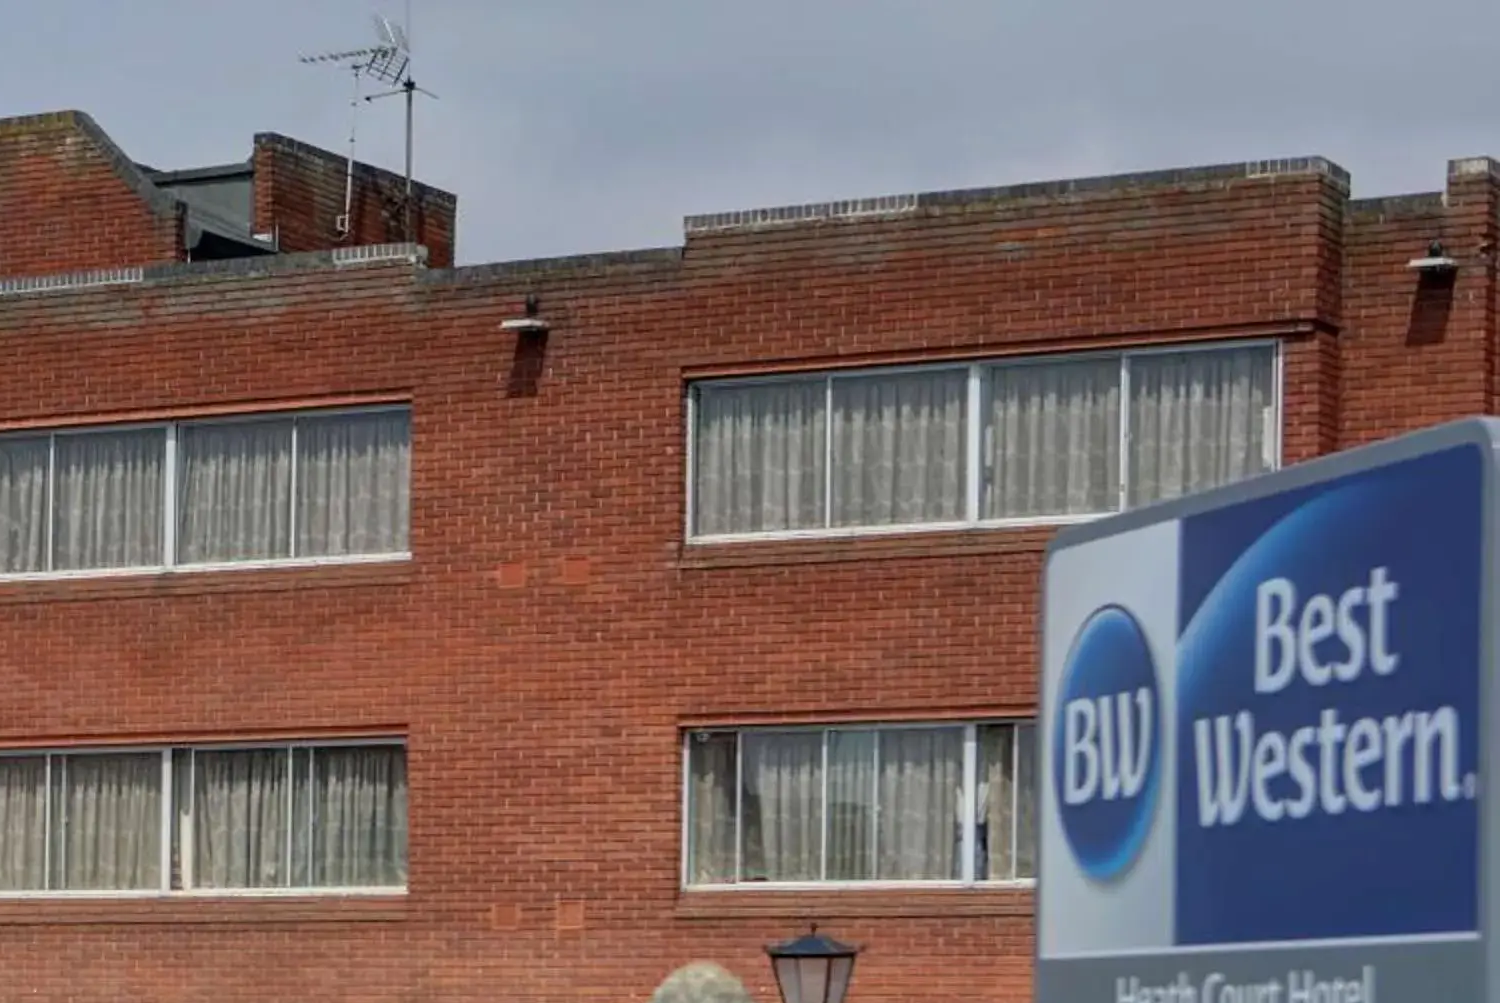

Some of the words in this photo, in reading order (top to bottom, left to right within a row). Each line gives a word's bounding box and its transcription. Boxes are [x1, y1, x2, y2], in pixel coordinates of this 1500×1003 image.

[1255, 567, 1398, 693] Best
[1064, 686, 1152, 805] BW
[1195, 704, 1462, 828] Western
